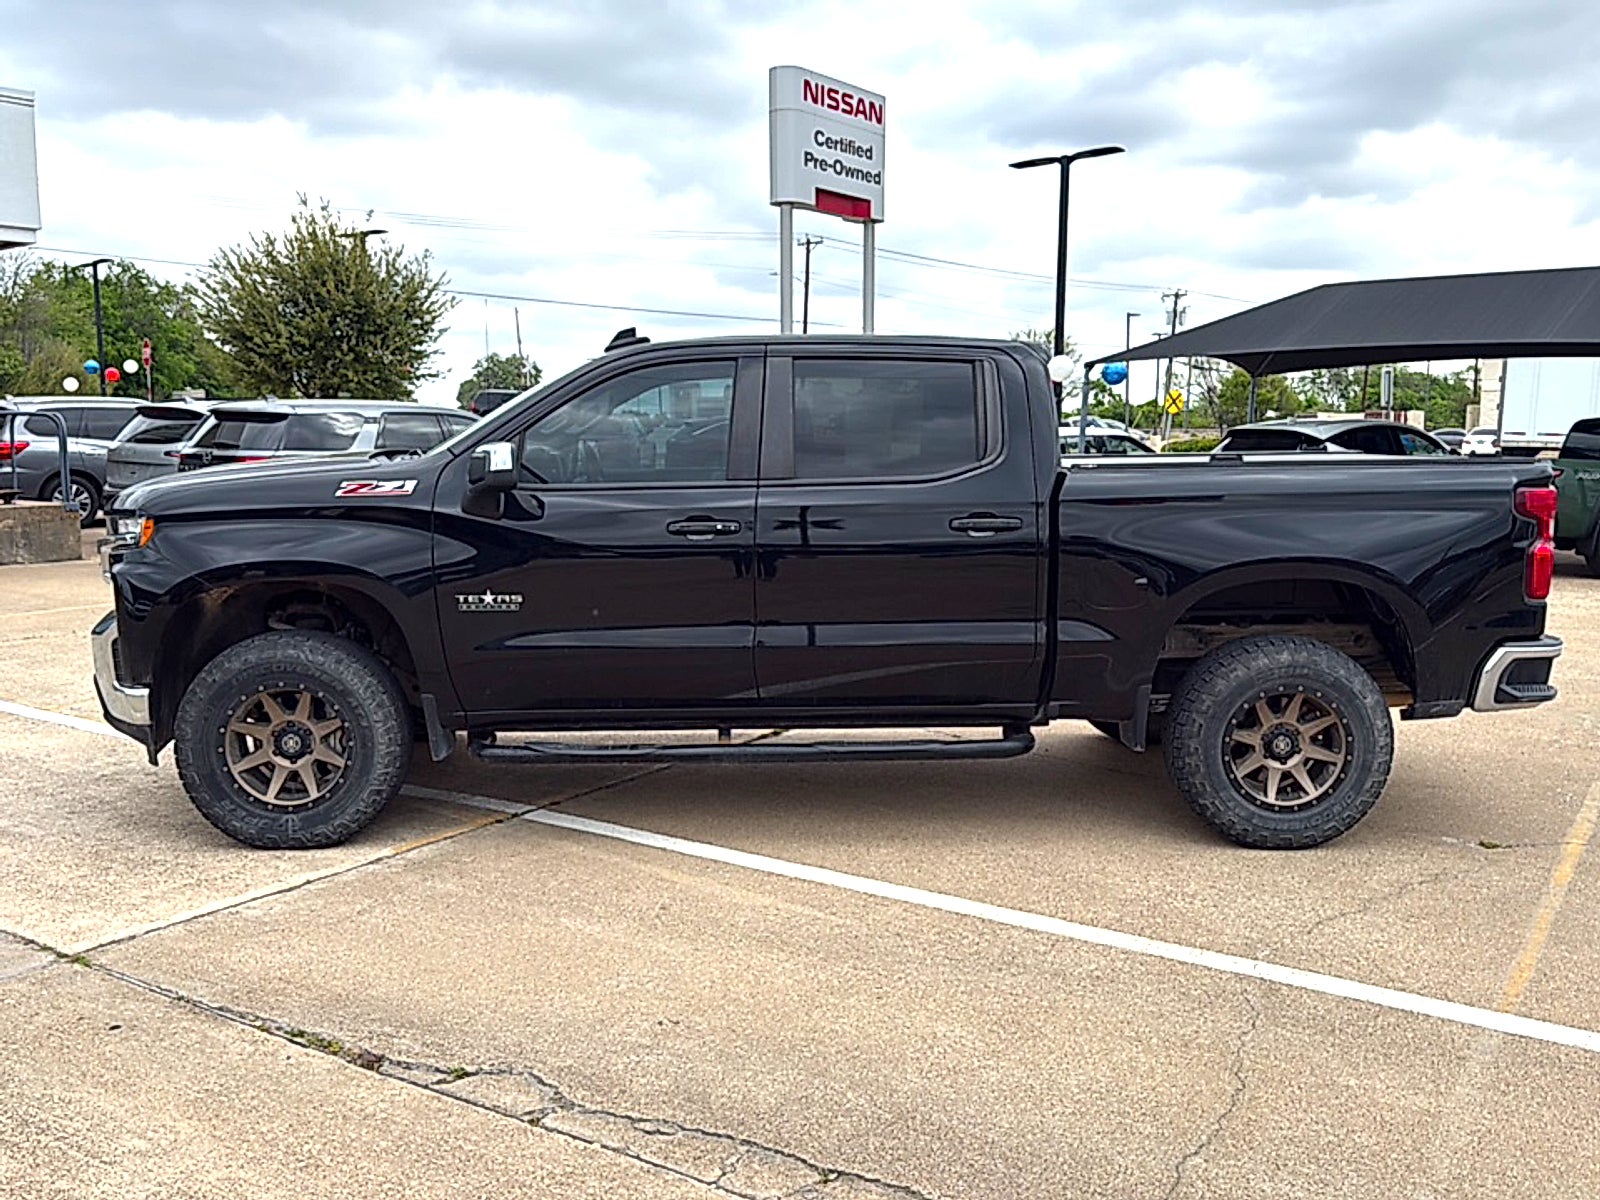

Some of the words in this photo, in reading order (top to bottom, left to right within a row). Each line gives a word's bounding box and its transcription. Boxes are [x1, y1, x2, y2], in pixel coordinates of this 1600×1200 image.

[803, 79, 883, 125] NISSAN
[814, 130, 873, 160] Certified
[804, 151, 882, 185] Pre-Owned
[334, 480, 418, 497] Z71
